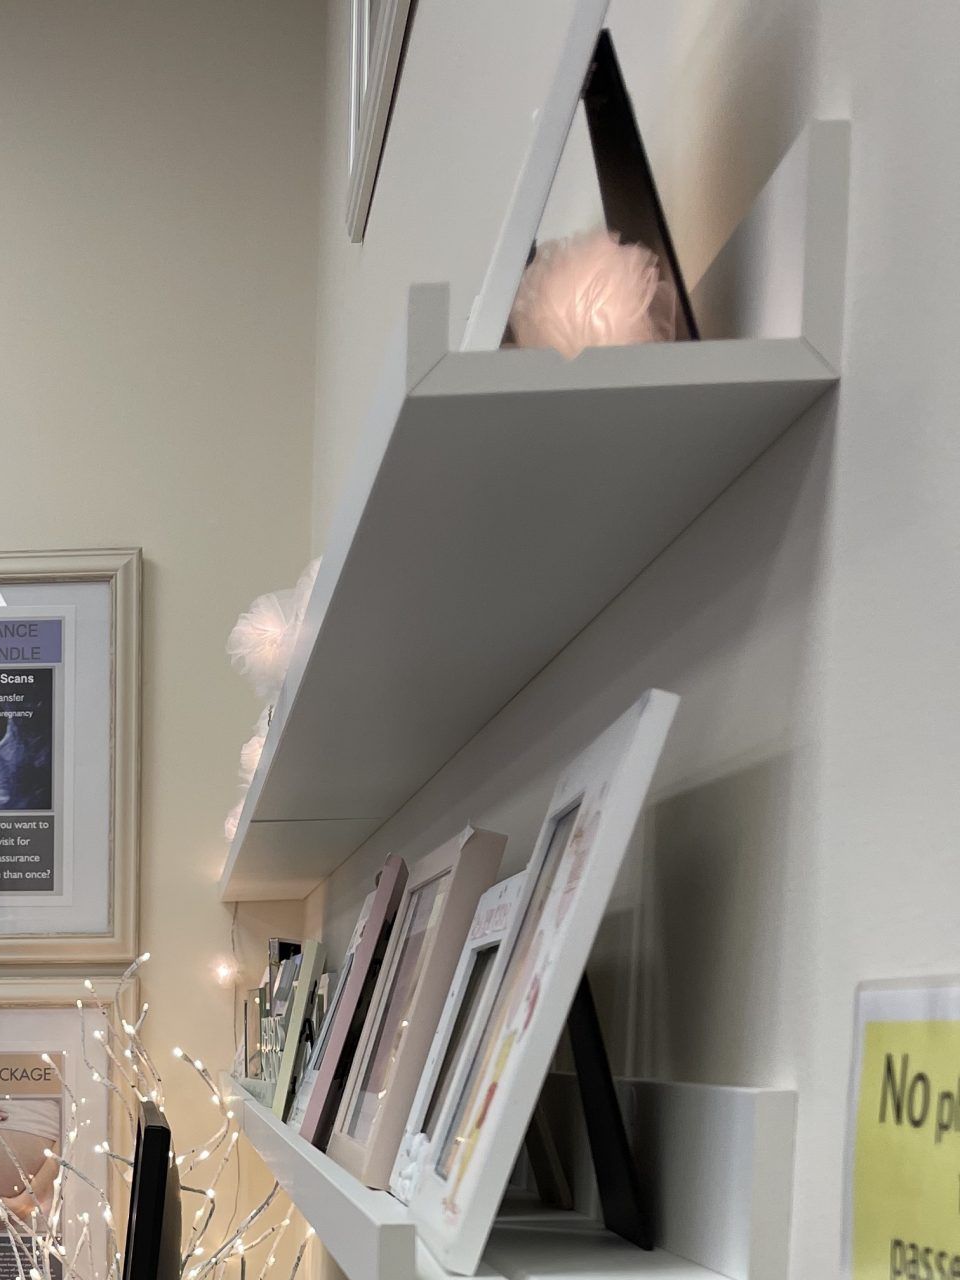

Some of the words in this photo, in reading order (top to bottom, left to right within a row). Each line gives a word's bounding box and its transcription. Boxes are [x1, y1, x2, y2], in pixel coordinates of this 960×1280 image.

[0, 673, 35, 684] Scans
[14, 821, 37, 829] want
[39, 821, 49, 829] to
[16, 837, 31, 846] for
[3, 870, 23, 879] than
[25, 870, 50, 879] once?
[878, 1052, 930, 1128] No
